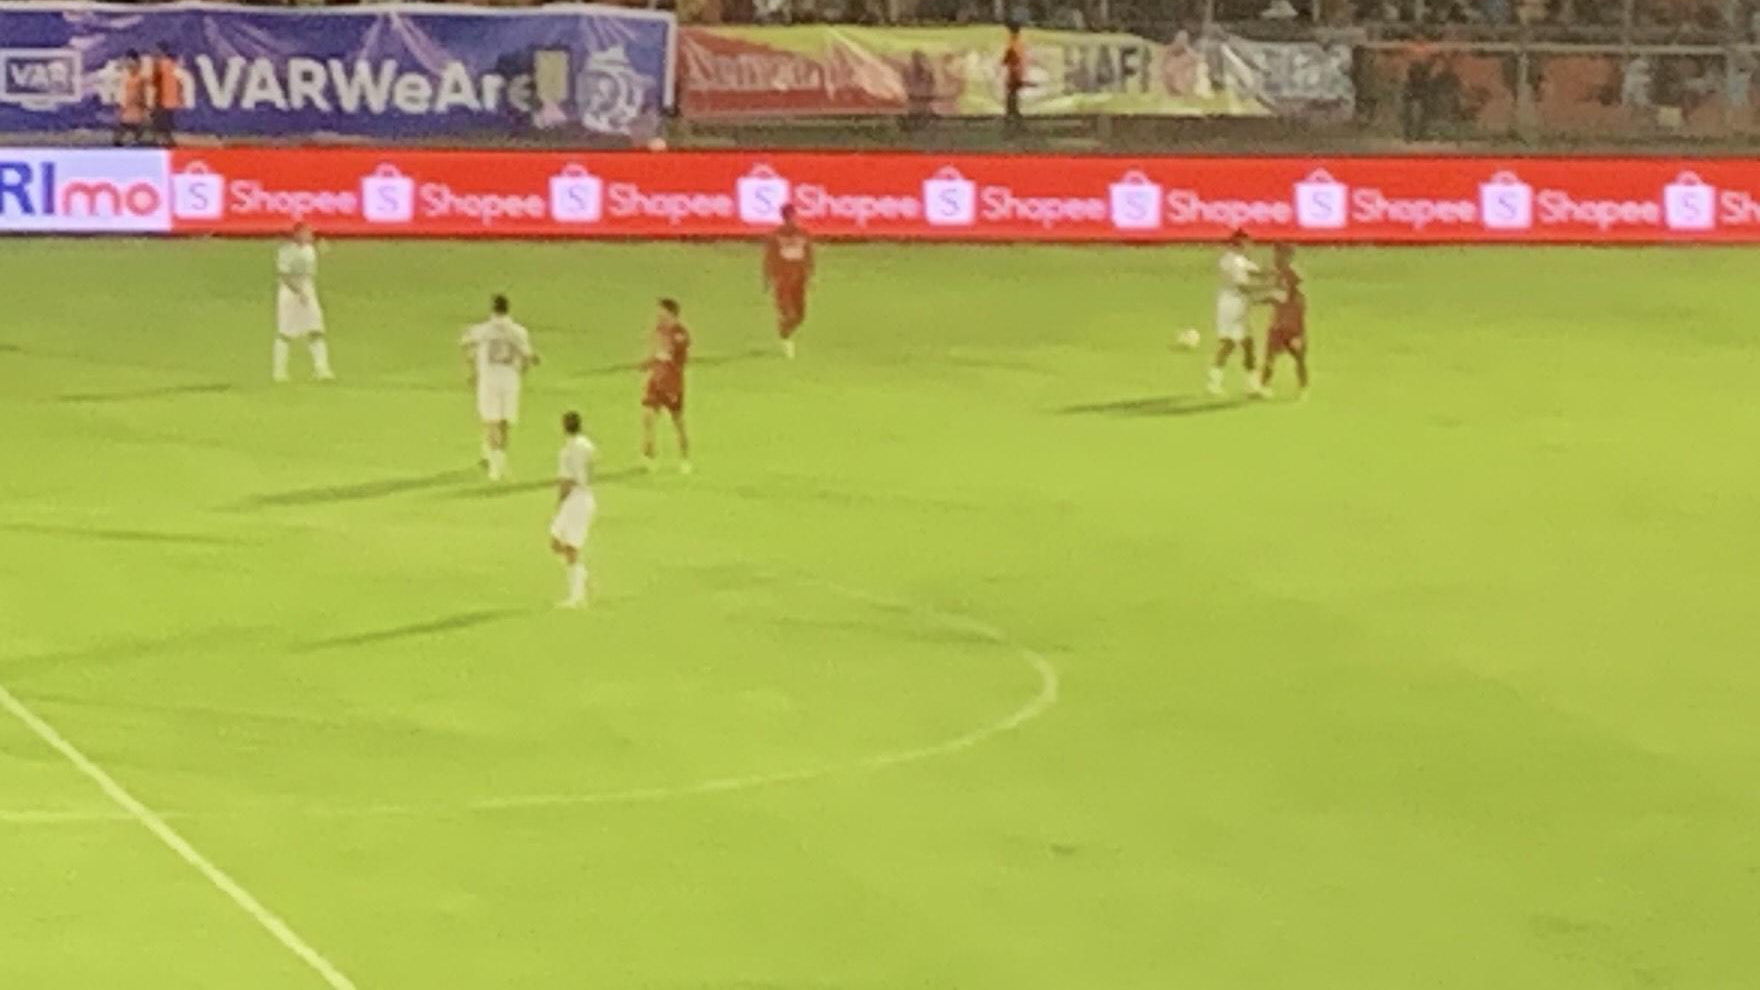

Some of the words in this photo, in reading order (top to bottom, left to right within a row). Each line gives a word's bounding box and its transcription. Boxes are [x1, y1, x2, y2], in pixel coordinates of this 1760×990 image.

[7, 62, 73, 89] VAR
[230, 180, 357, 220] Shopee
[420, 182, 545, 225] Shopee
[609, 183, 734, 225] Shopee
[795, 185, 918, 225] Shopee
[981, 187, 1105, 227] Shopee
[1167, 189, 1290, 228] Shopee
[1352, 189, 1476, 228] Shopee
[1537, 190, 1659, 230] Shopee
